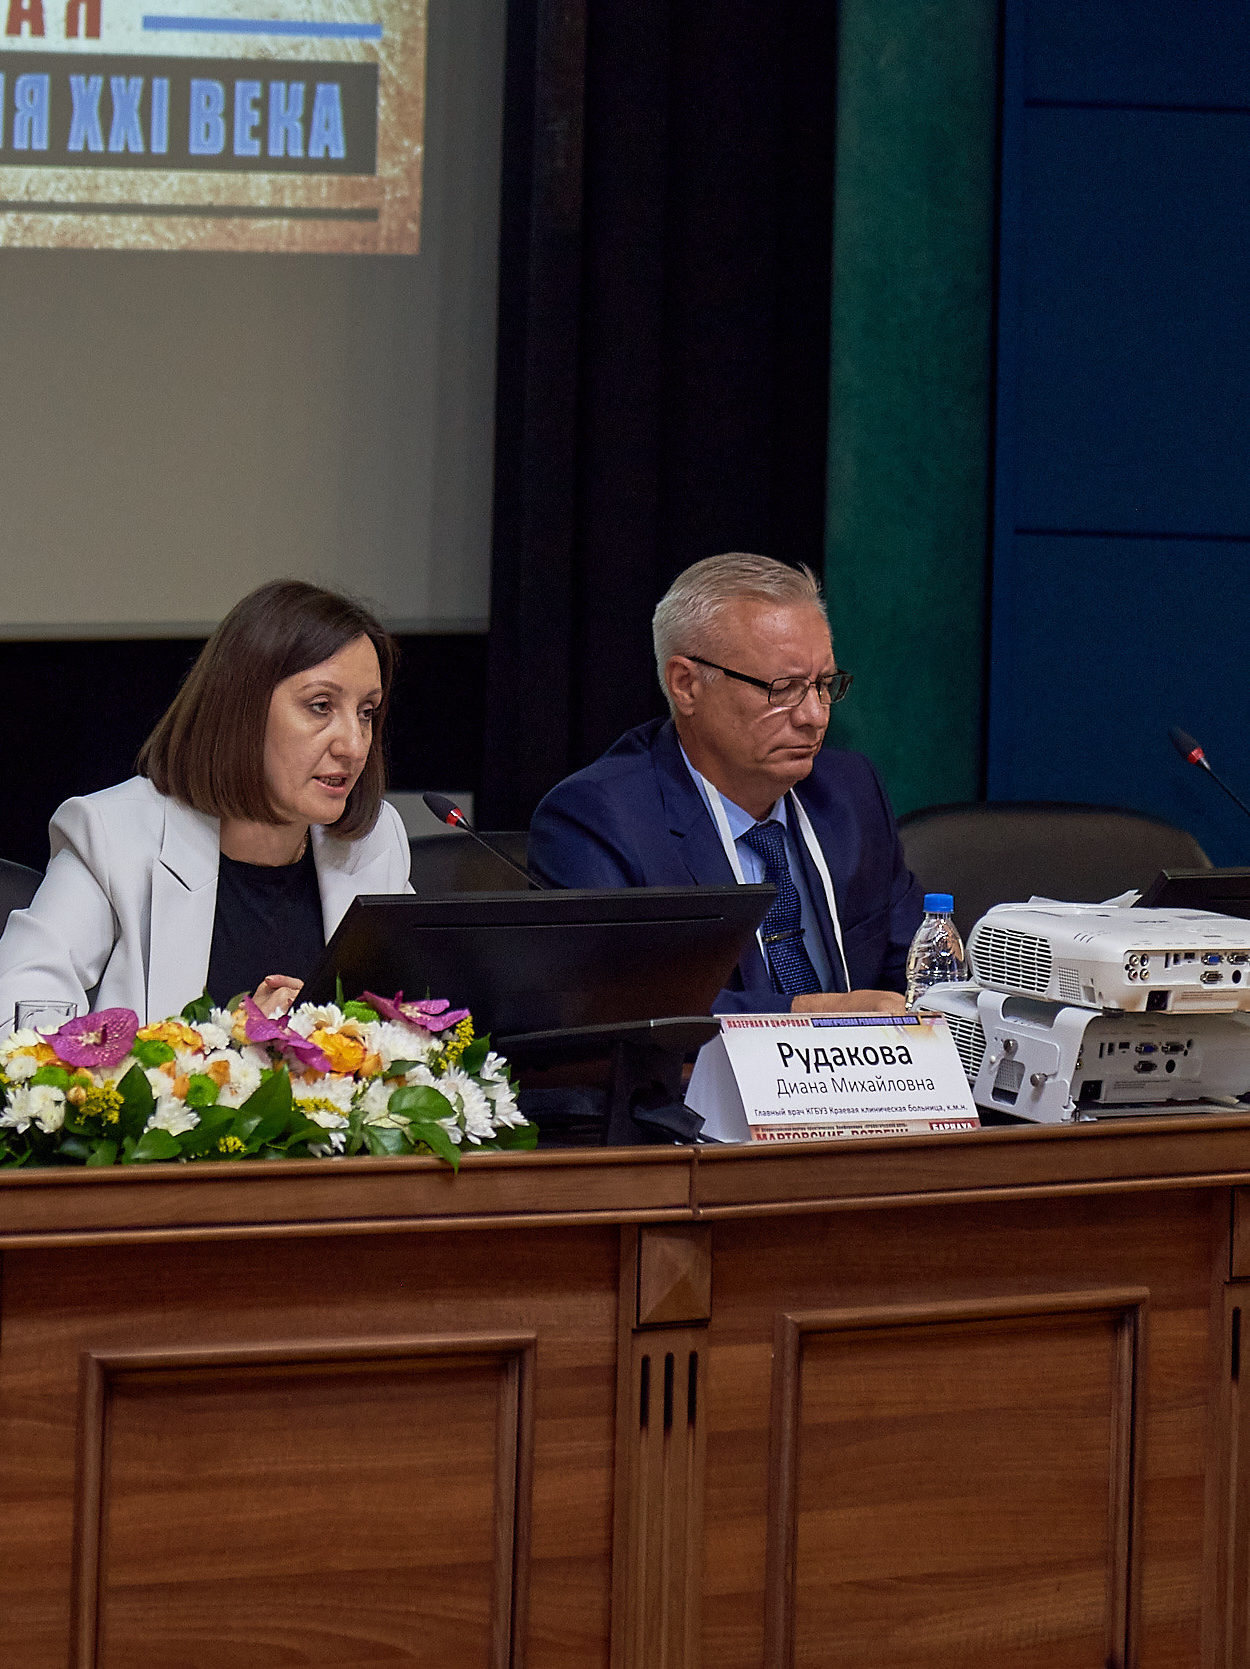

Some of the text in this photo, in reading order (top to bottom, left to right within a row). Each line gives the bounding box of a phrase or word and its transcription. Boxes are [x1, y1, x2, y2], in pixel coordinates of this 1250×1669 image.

[68, 75, 170, 154] XXI
[189, 79, 347, 160] ВЕКА
[777, 1042, 913, 1073] Рудакова
[777, 1075, 935, 1098] Диана Михайловна
[754, 1108, 786, 1116] Главный
[787, 1109, 804, 1117] врач
[806, 1106, 828, 1115] КГБУЗ
[829, 1106, 859, 1115] Краевая
[908, 1104, 946, 1112] больница,
